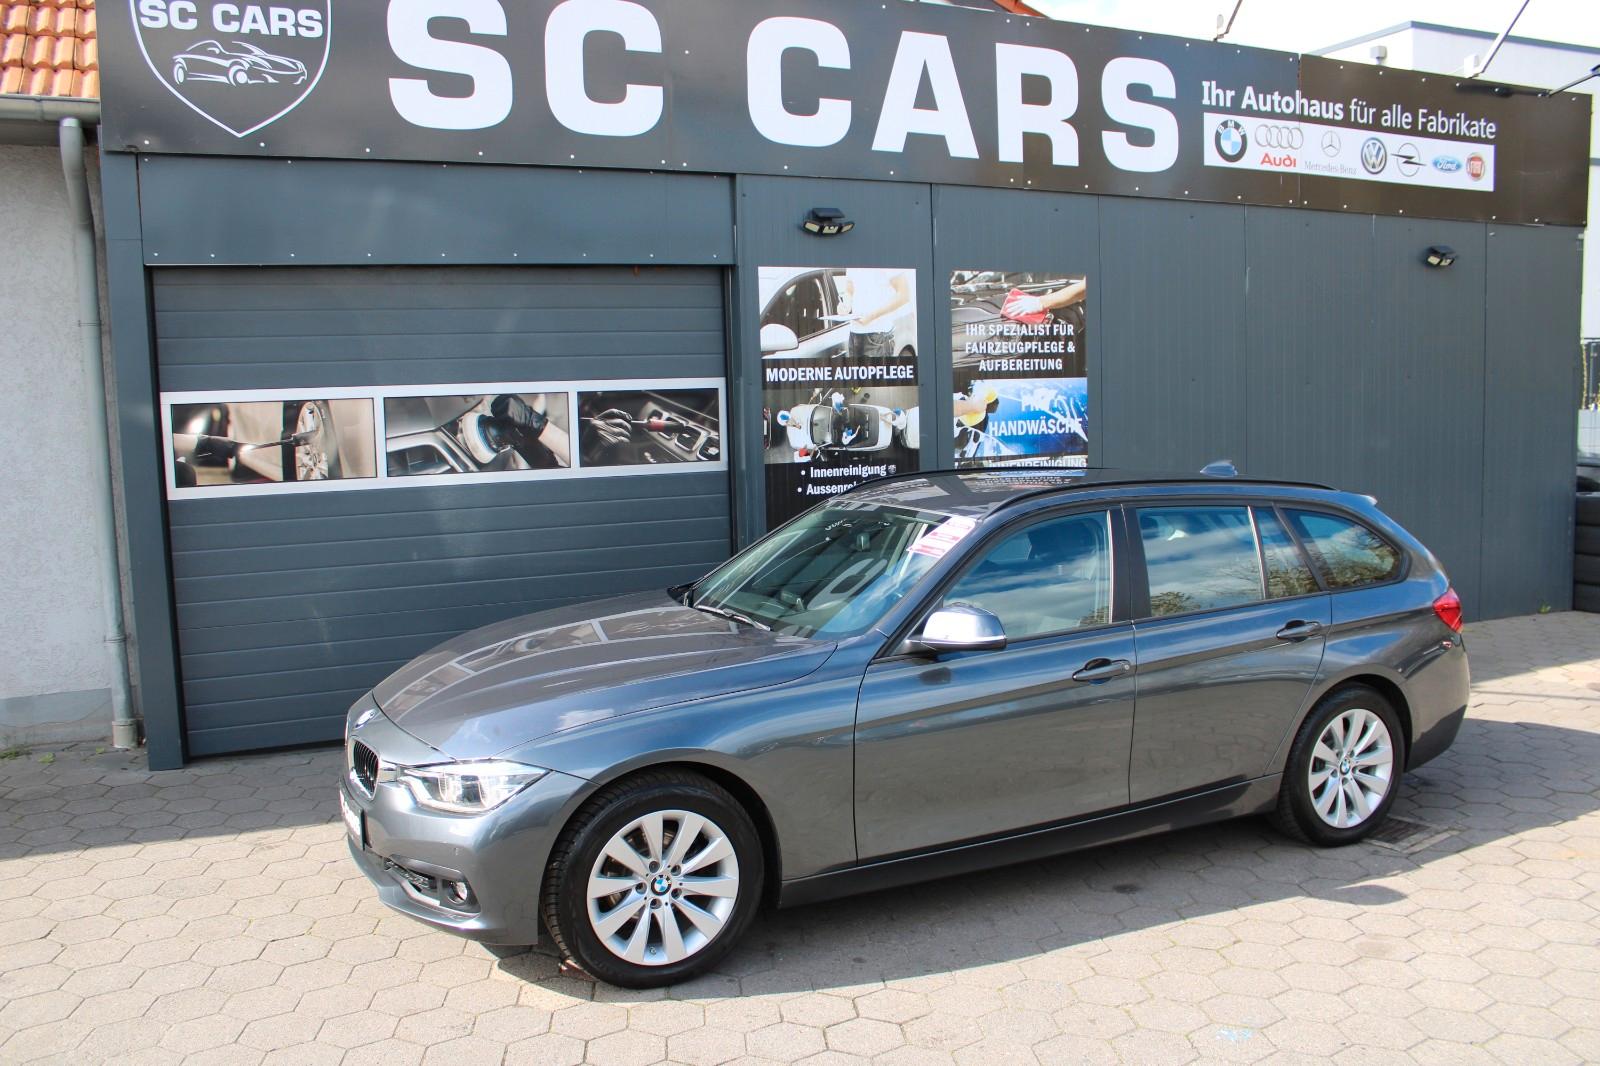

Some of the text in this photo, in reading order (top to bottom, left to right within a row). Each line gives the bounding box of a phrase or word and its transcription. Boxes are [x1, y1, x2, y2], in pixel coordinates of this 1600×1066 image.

[139, 0, 324, 38] SC CARS
[387, 0, 1179, 173] SC CARS
[1201, 80, 1496, 140] Ihr Autohaus für alle Fabrikate
[1260, 153, 1296, 168] Audi
[965, 320, 1074, 336] IHR SPEZIALIST FÜR
[965, 341, 1076, 354] FAHRZEUGPFLEGE &
[979, 358, 1063, 372] AUFBEREITUNG
[766, 365, 915, 382] MODERNE AUTOPFLEGE
[810, 464, 887, 478] Innenreinigung
